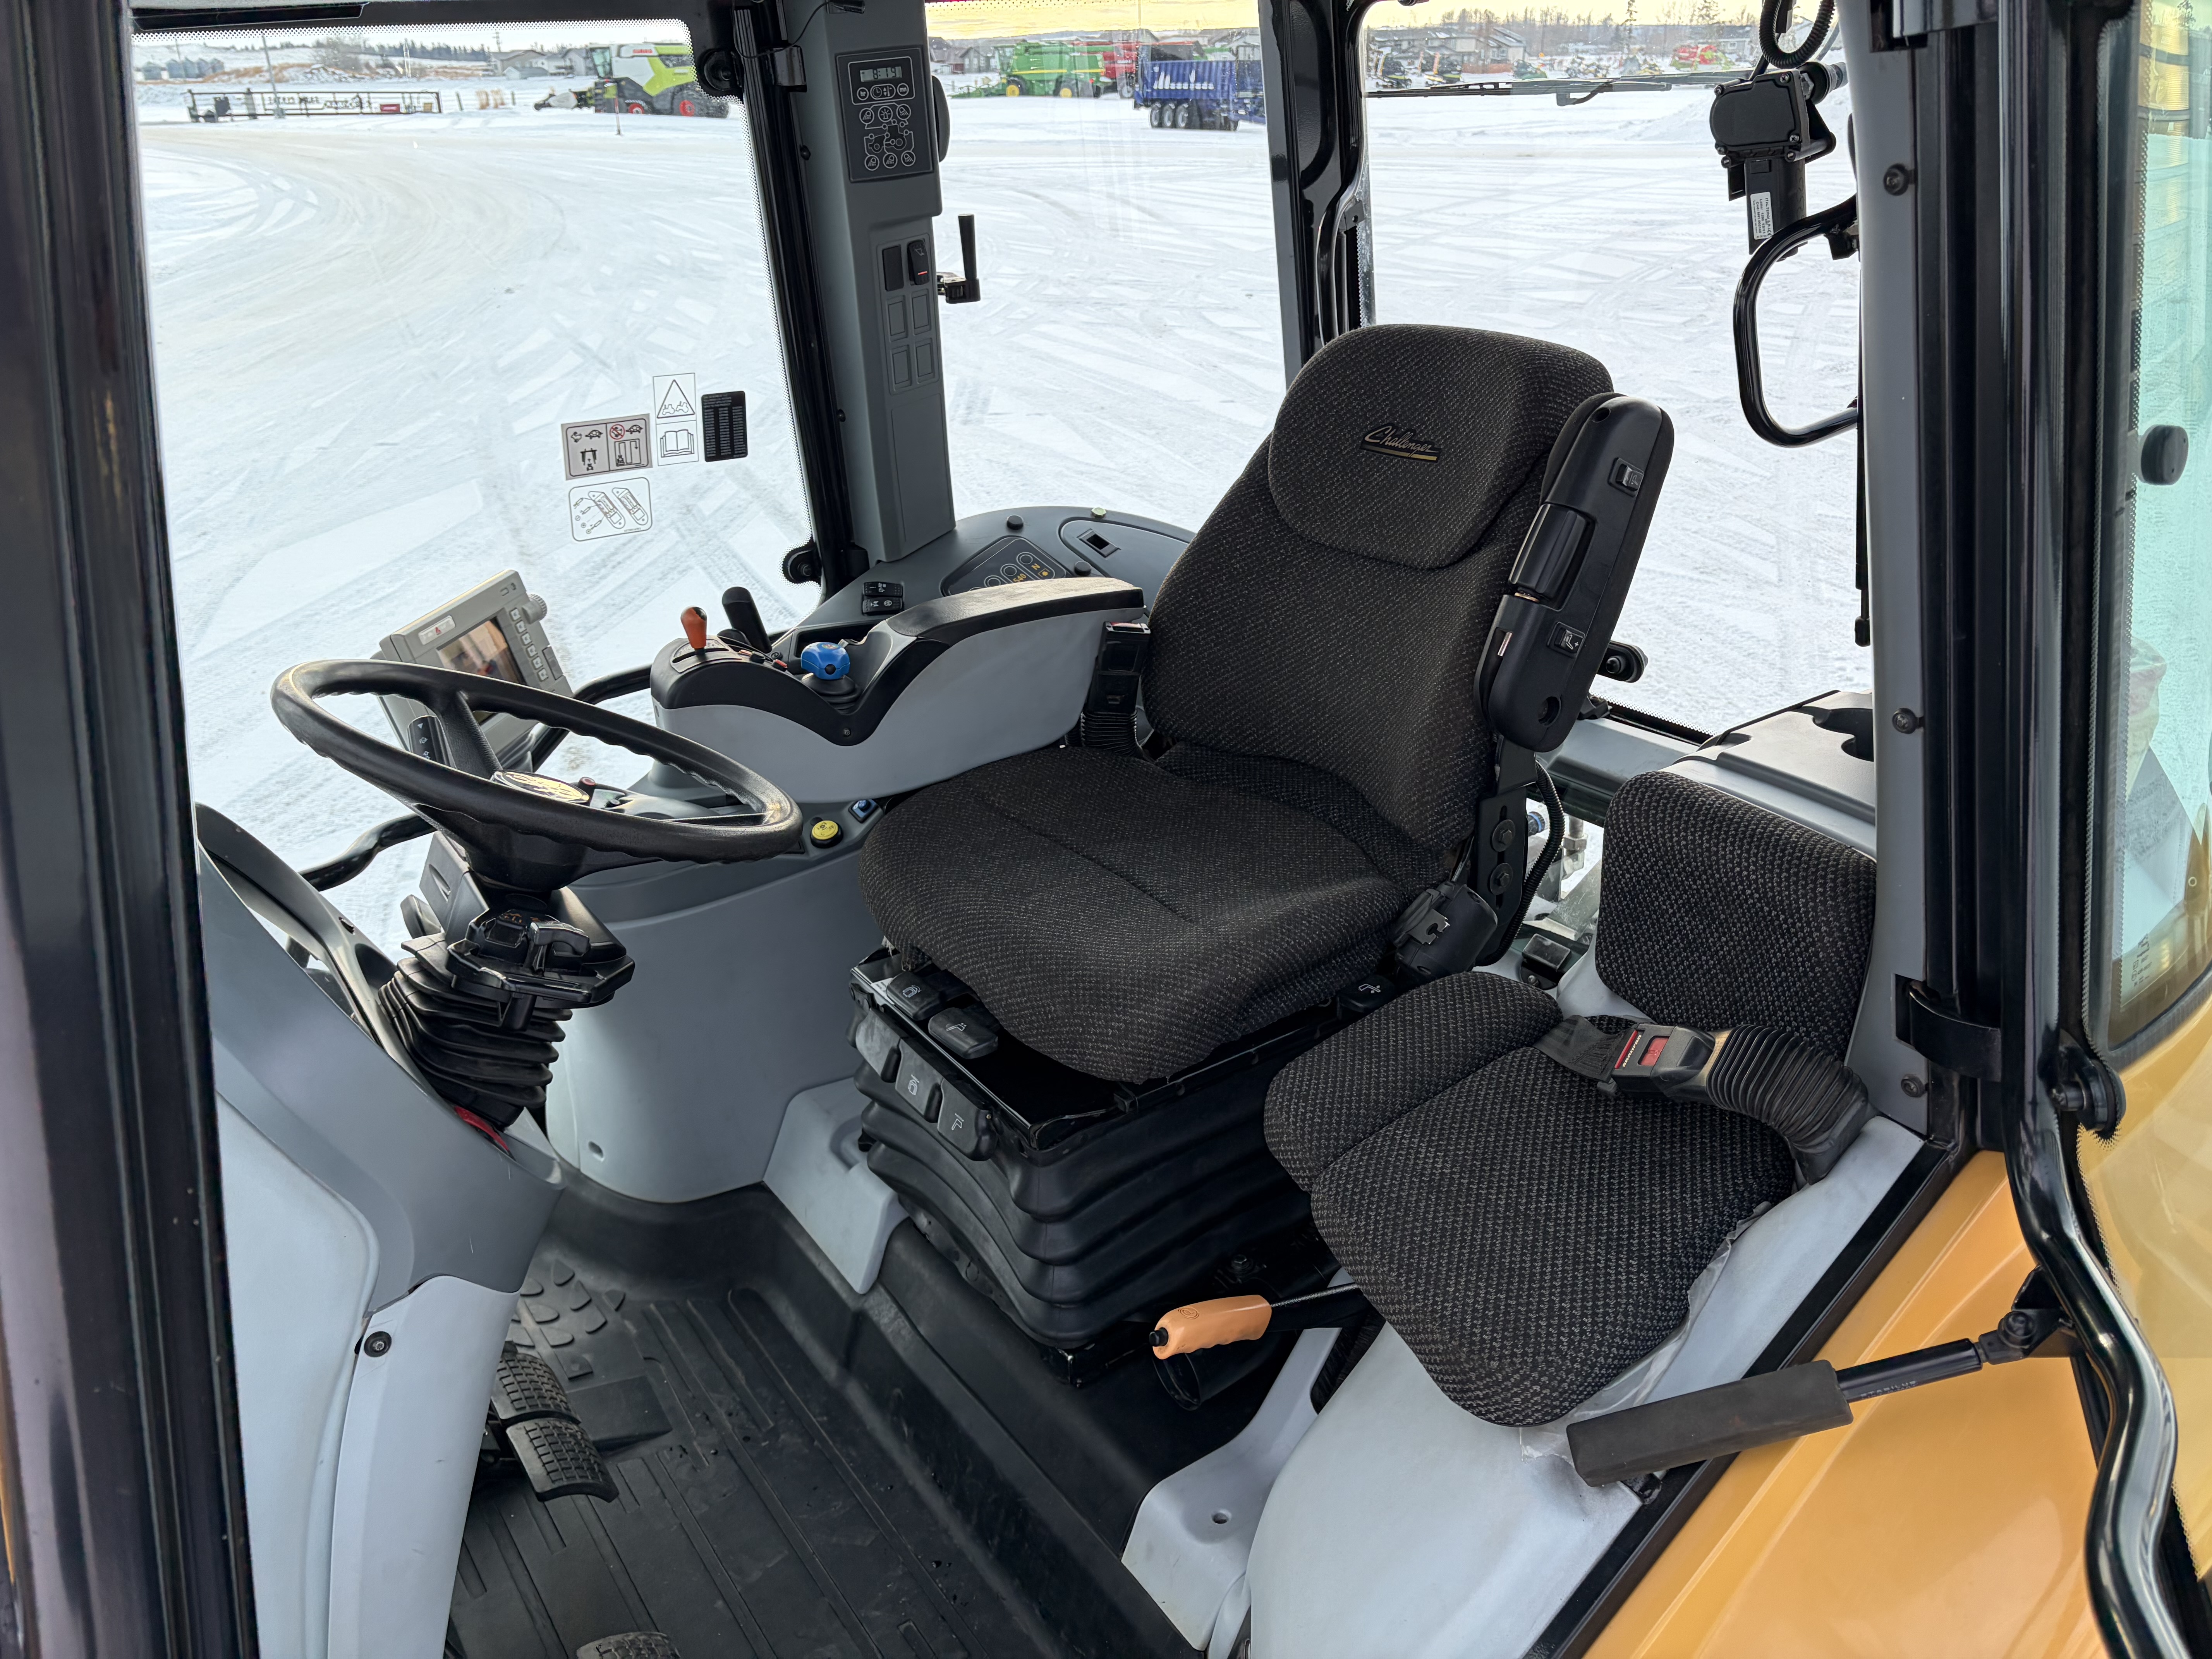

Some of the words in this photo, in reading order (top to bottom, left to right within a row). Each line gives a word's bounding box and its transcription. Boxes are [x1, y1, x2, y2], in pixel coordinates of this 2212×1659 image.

[872, 67, 896, 79] 8:19
[1364, 426, 1439, 458] Challenger
[1013, 573, 1027, 582] 540
